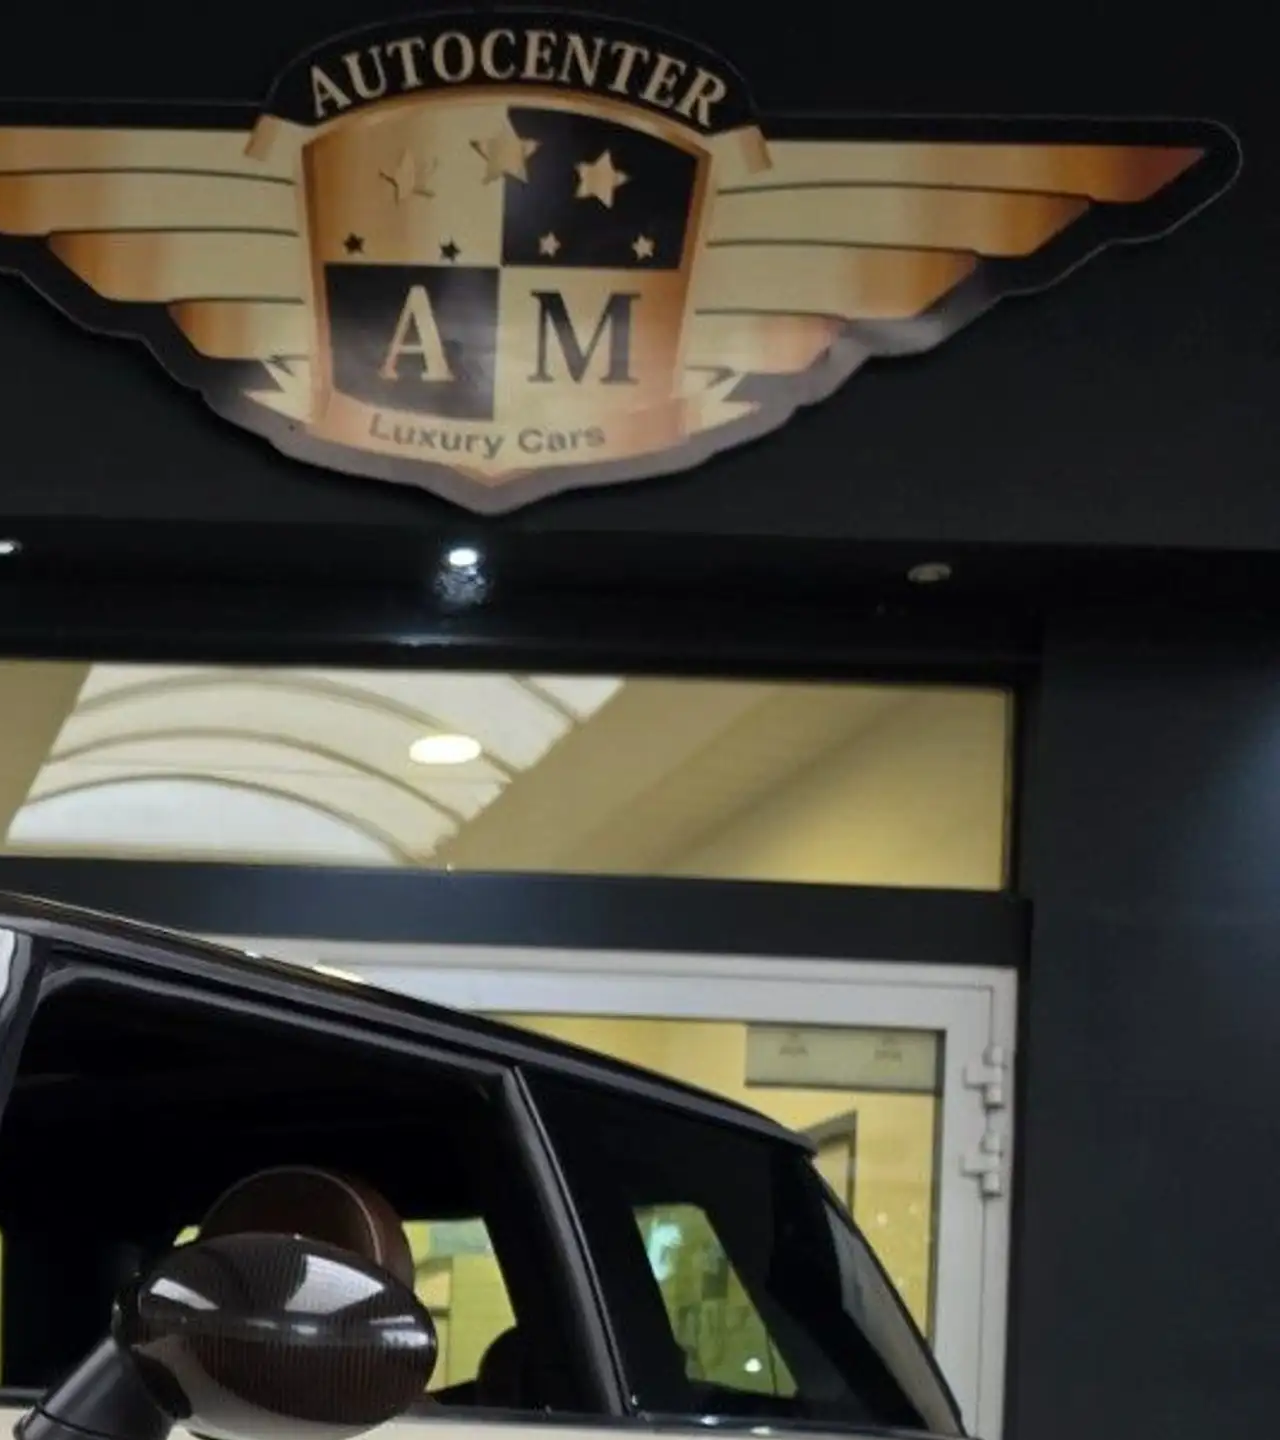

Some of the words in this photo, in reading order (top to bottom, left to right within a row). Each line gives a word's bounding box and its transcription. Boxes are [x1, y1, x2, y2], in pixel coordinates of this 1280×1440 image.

[308, 28, 729, 128] AUTOCENTER
[378, 284, 457, 383] A
[527, 289, 643, 385] M
[368, 412, 505, 460] Luxury
[517, 423, 606, 455] Cars
